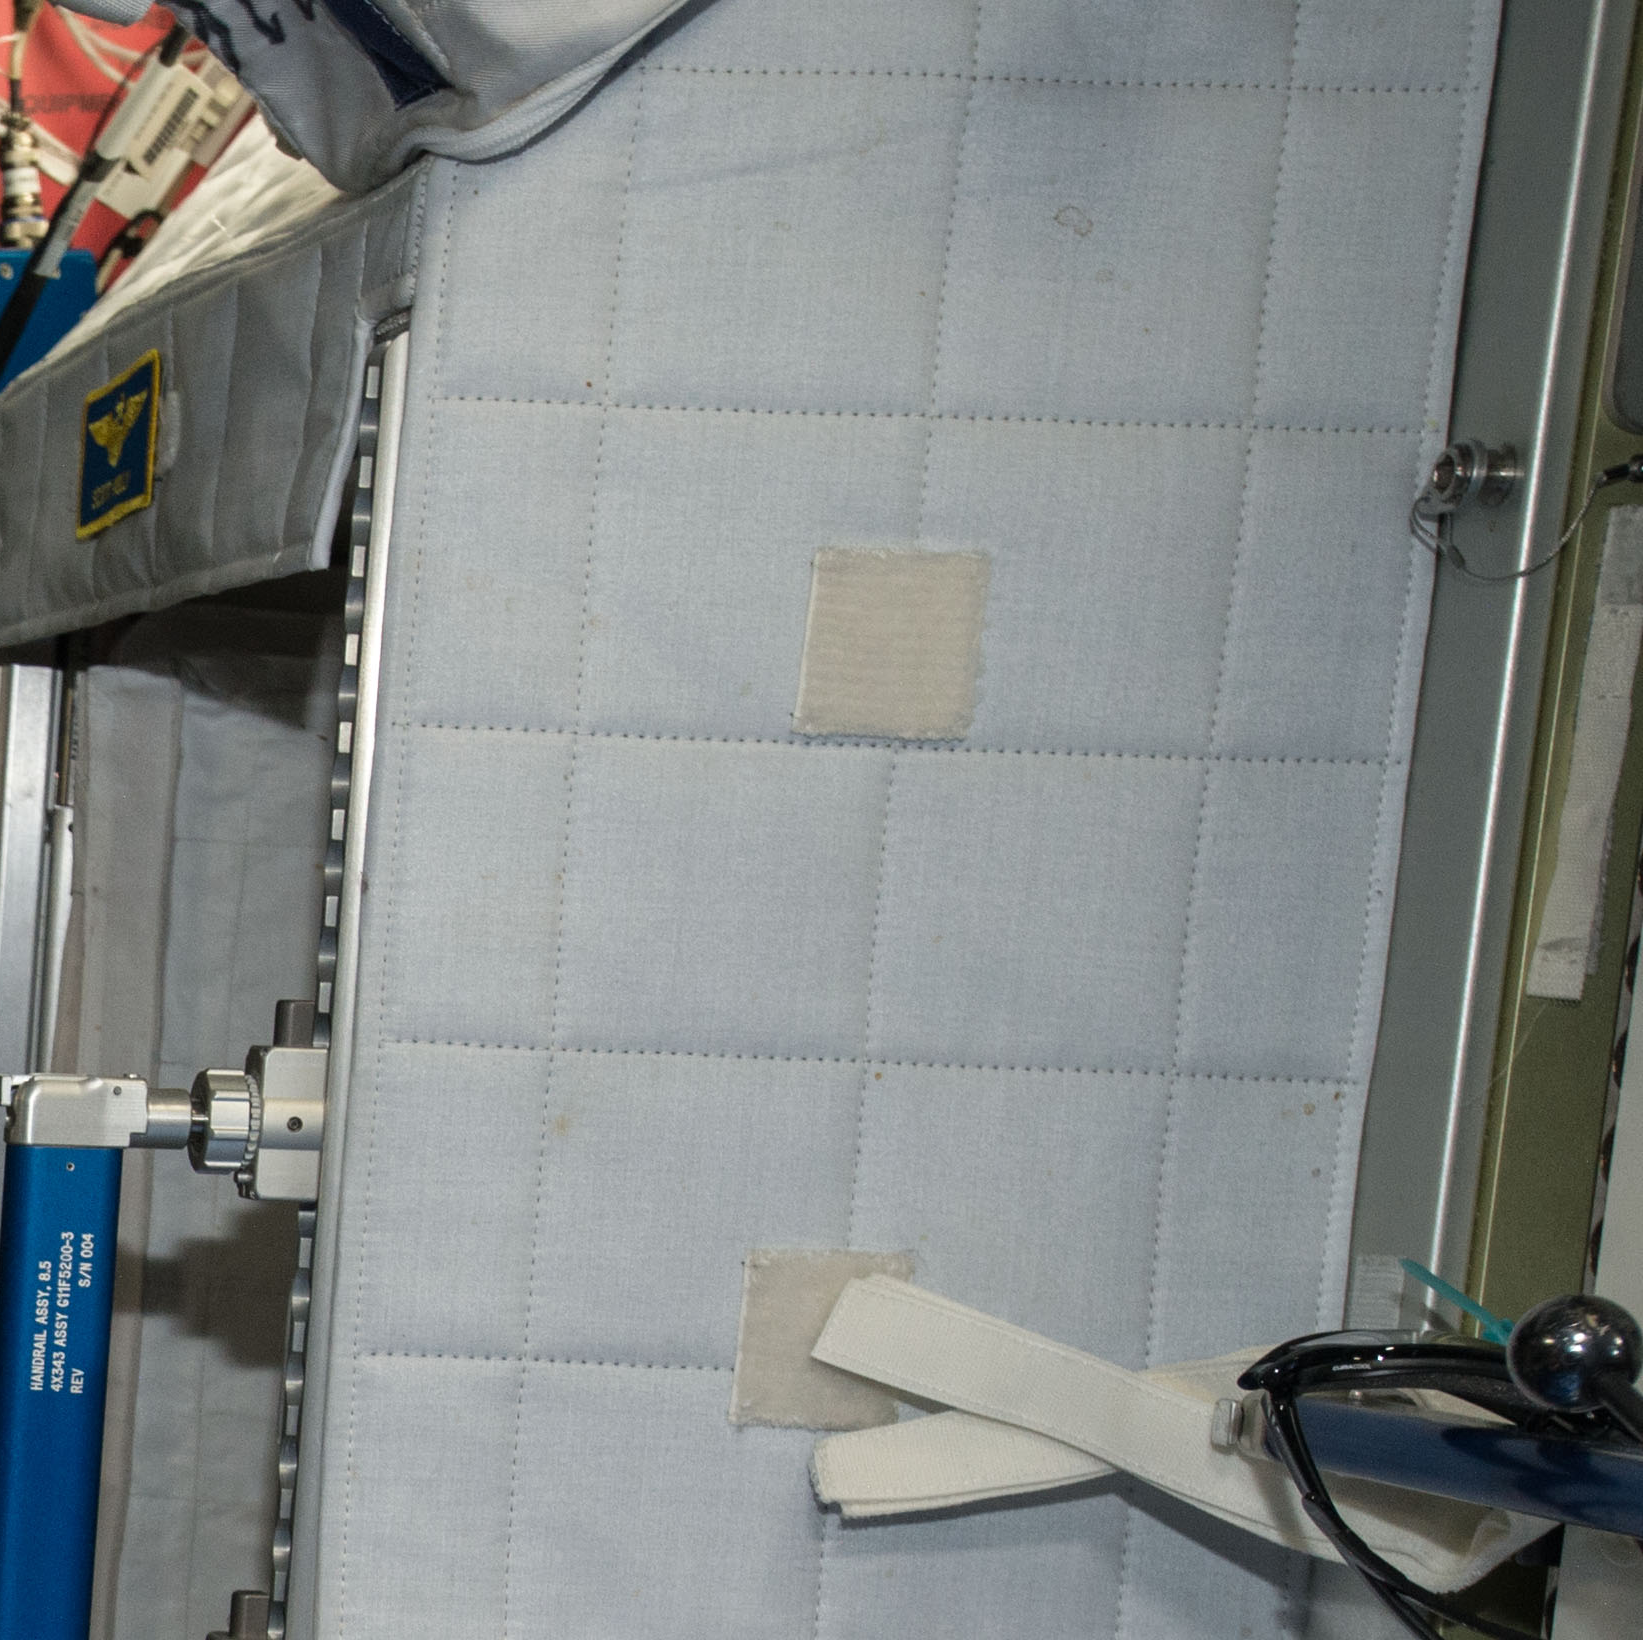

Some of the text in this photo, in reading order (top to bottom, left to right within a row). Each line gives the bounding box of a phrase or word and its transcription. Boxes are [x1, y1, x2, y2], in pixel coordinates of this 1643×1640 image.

[30, 1260, 53, 1391] HANDRAIL ASSY, 8.5
[51, 1231, 75, 1392] 4X343 ASSY G11F5200-3
[70, 1233, 95, 1394] REV S/N 004
